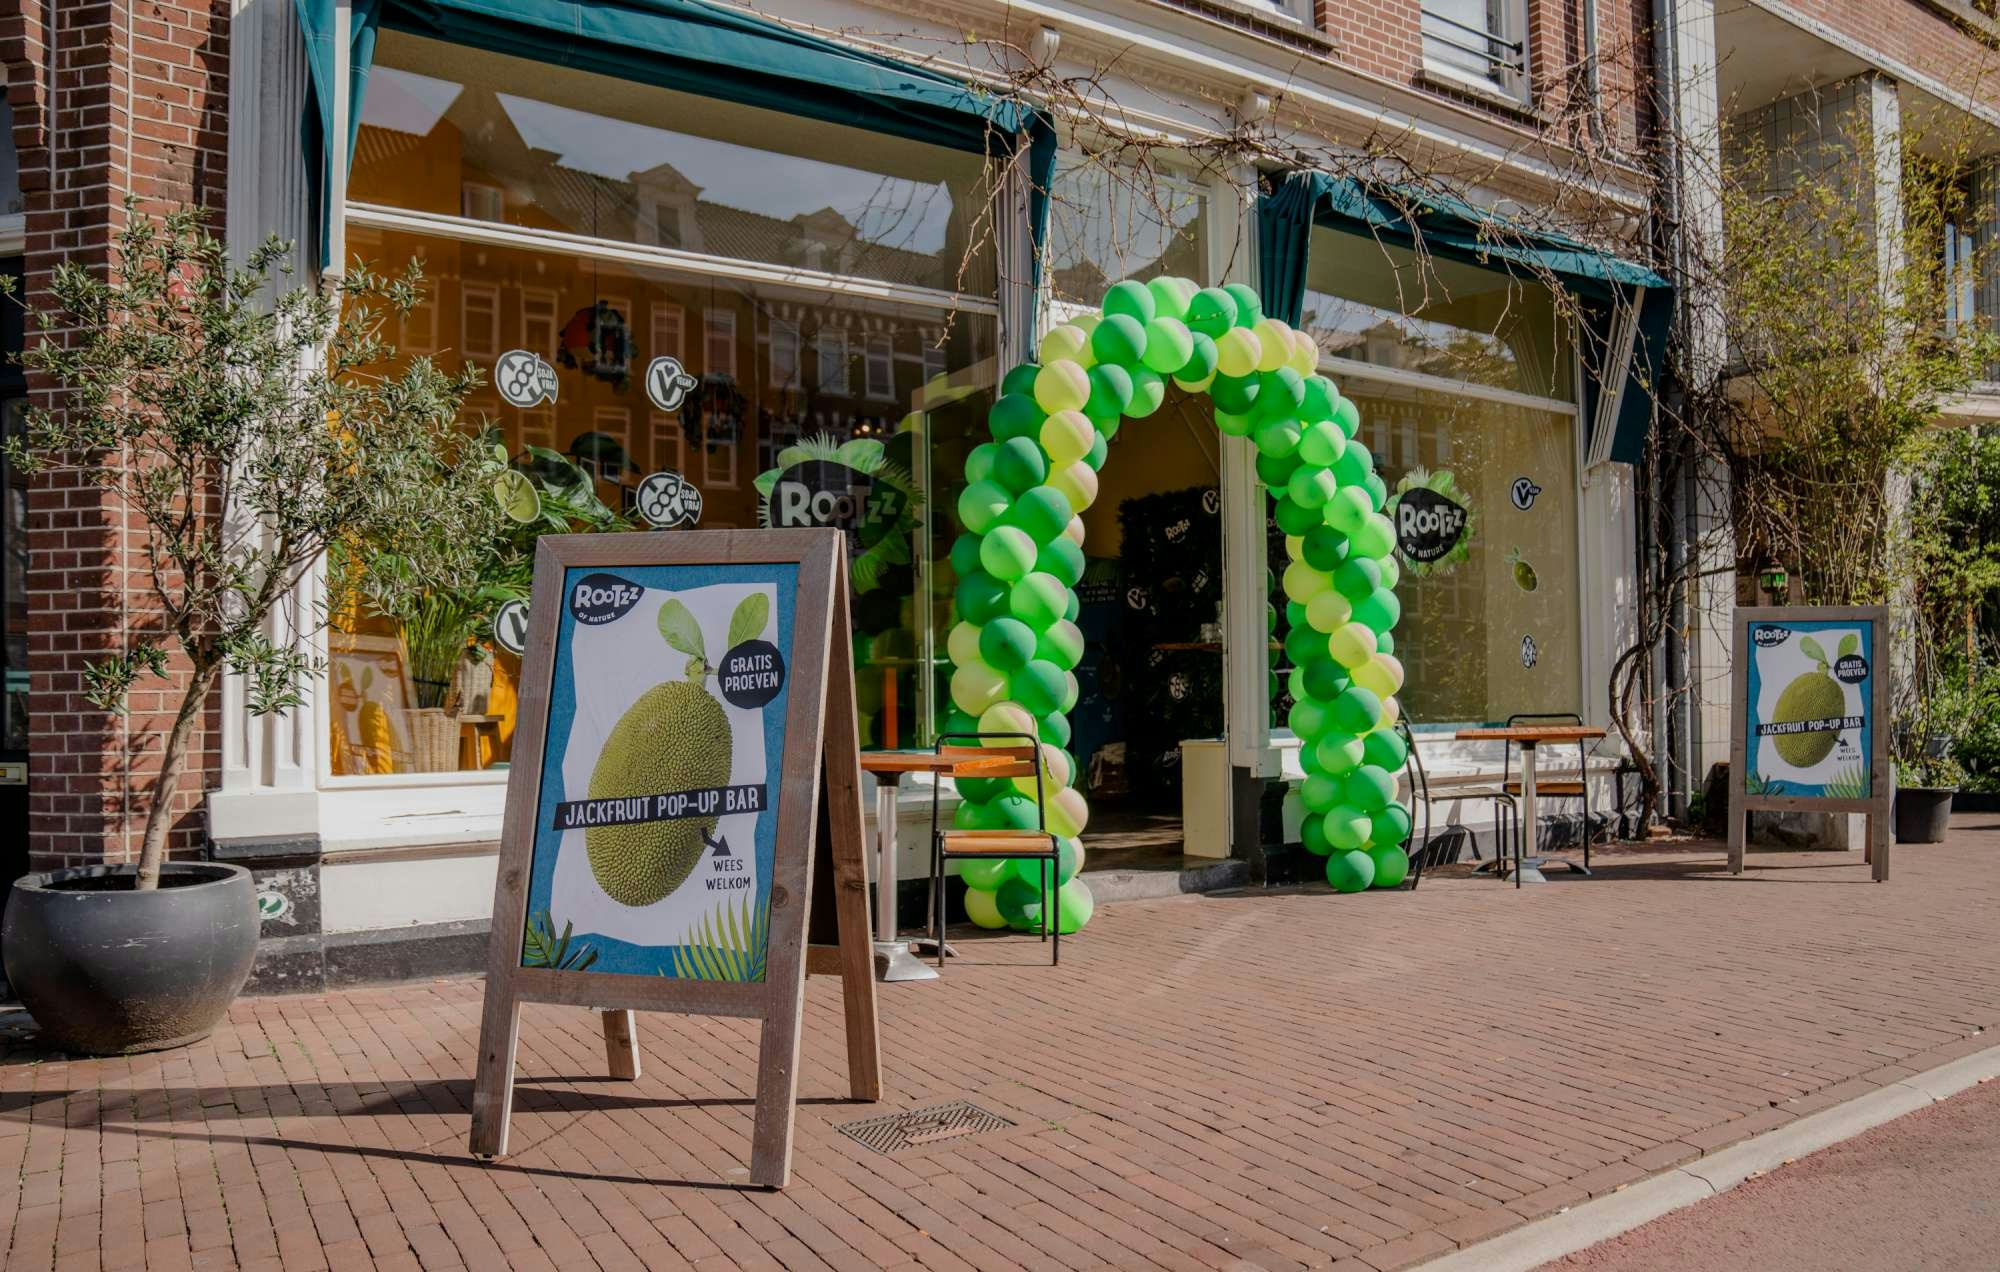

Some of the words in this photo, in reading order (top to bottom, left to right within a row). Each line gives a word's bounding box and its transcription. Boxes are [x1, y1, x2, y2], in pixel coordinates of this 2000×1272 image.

[541, 379, 556, 390] VRIJ
[681, 489, 697, 500] SOJA
[684, 500, 700, 511] VRIJ
[1406, 543, 1417, 554] OF
[1418, 545, 1444, 558] NATURE
[578, 612, 588, 620] OF
[588, 611, 616, 622] NATURE
[730, 654, 773, 673] GRATIS
[1840, 660, 1862, 669] GRATIS
[1838, 667, 1866, 677] PROEVEN
[725, 671, 779, 692] PROEVEN
[1761, 722, 1805, 735] JACKFRUIT
[1808, 719, 1841, 731] POP-UP
[1843, 717, 1861, 728] BAR
[565, 798, 650, 826] JACKFRUIT
[657, 791, 720, 817] POP-UP
[726, 787, 759, 810] BAR
[713, 859, 743, 872] WEES
[706, 876, 751, 891] WELKOM
